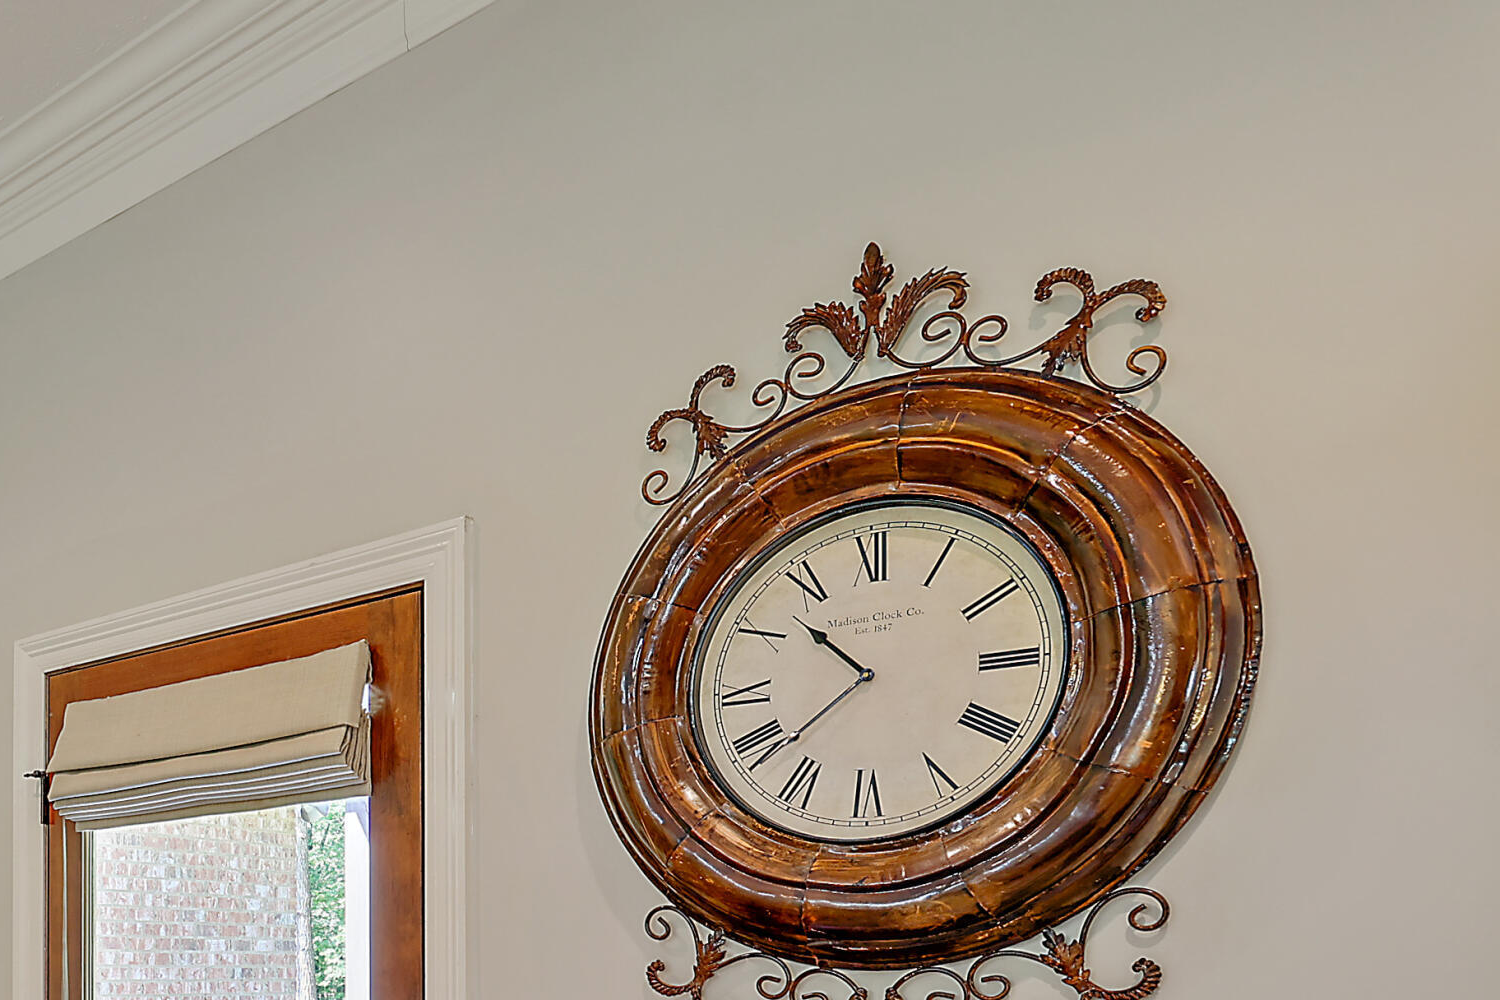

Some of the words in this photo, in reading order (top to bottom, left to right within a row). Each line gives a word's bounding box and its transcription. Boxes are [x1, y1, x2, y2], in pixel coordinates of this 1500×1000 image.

[854, 530, 890, 587] XII
[785, 559, 832, 613] XI
[827, 616, 870, 629] Madison
[872, 609, 902, 621] Clock
[906, 607, 925, 616] Co.
[854, 627, 870, 635] Est.
[874, 623, 893, 633] 1847
